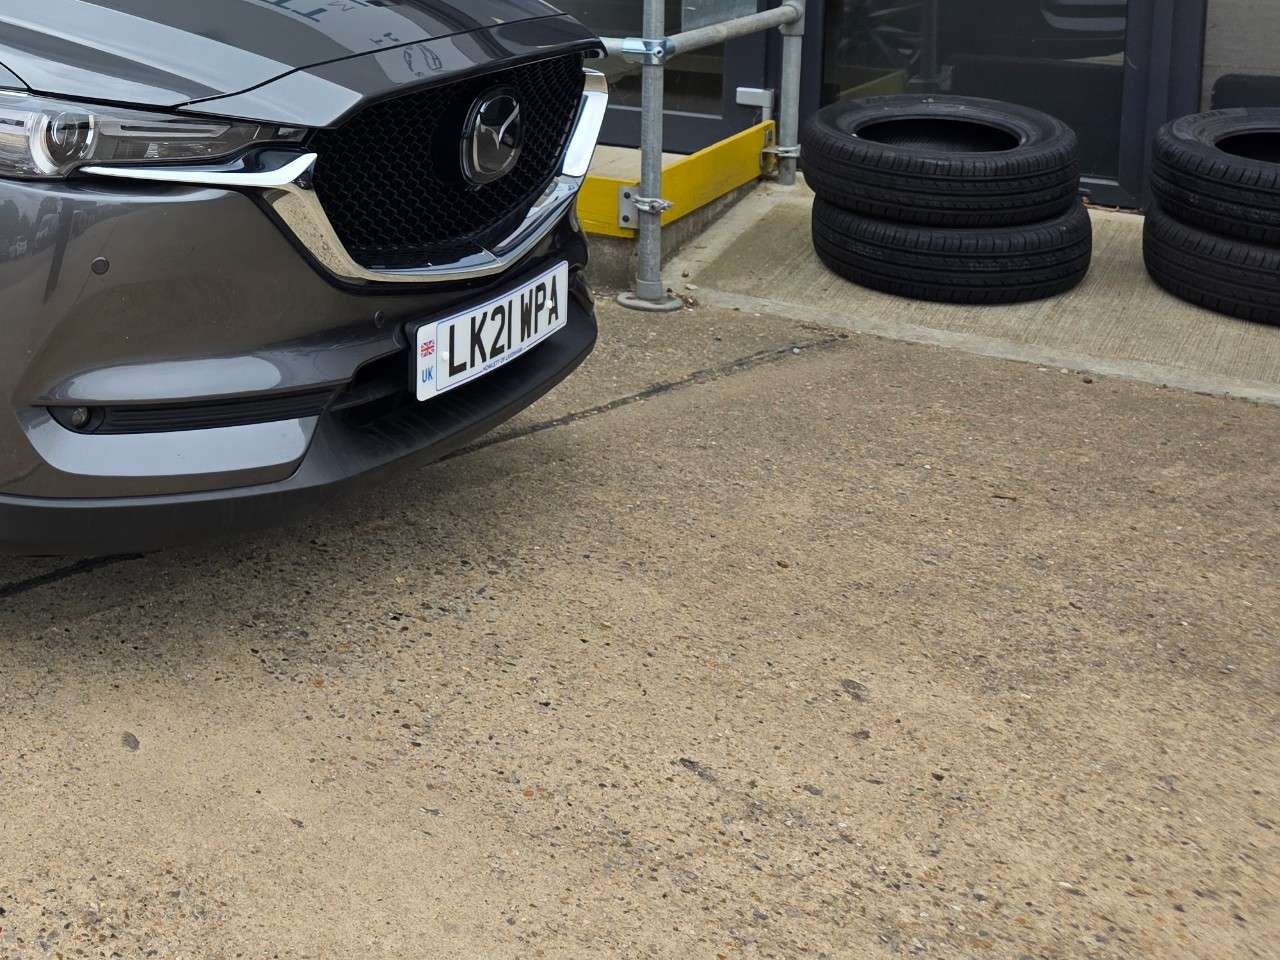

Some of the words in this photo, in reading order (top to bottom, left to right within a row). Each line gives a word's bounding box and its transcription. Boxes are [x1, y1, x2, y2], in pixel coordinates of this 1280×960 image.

[448, 300, 513, 378] LK21
[520, 275, 559, 342] WPA
[421, 367, 434, 384] UK
